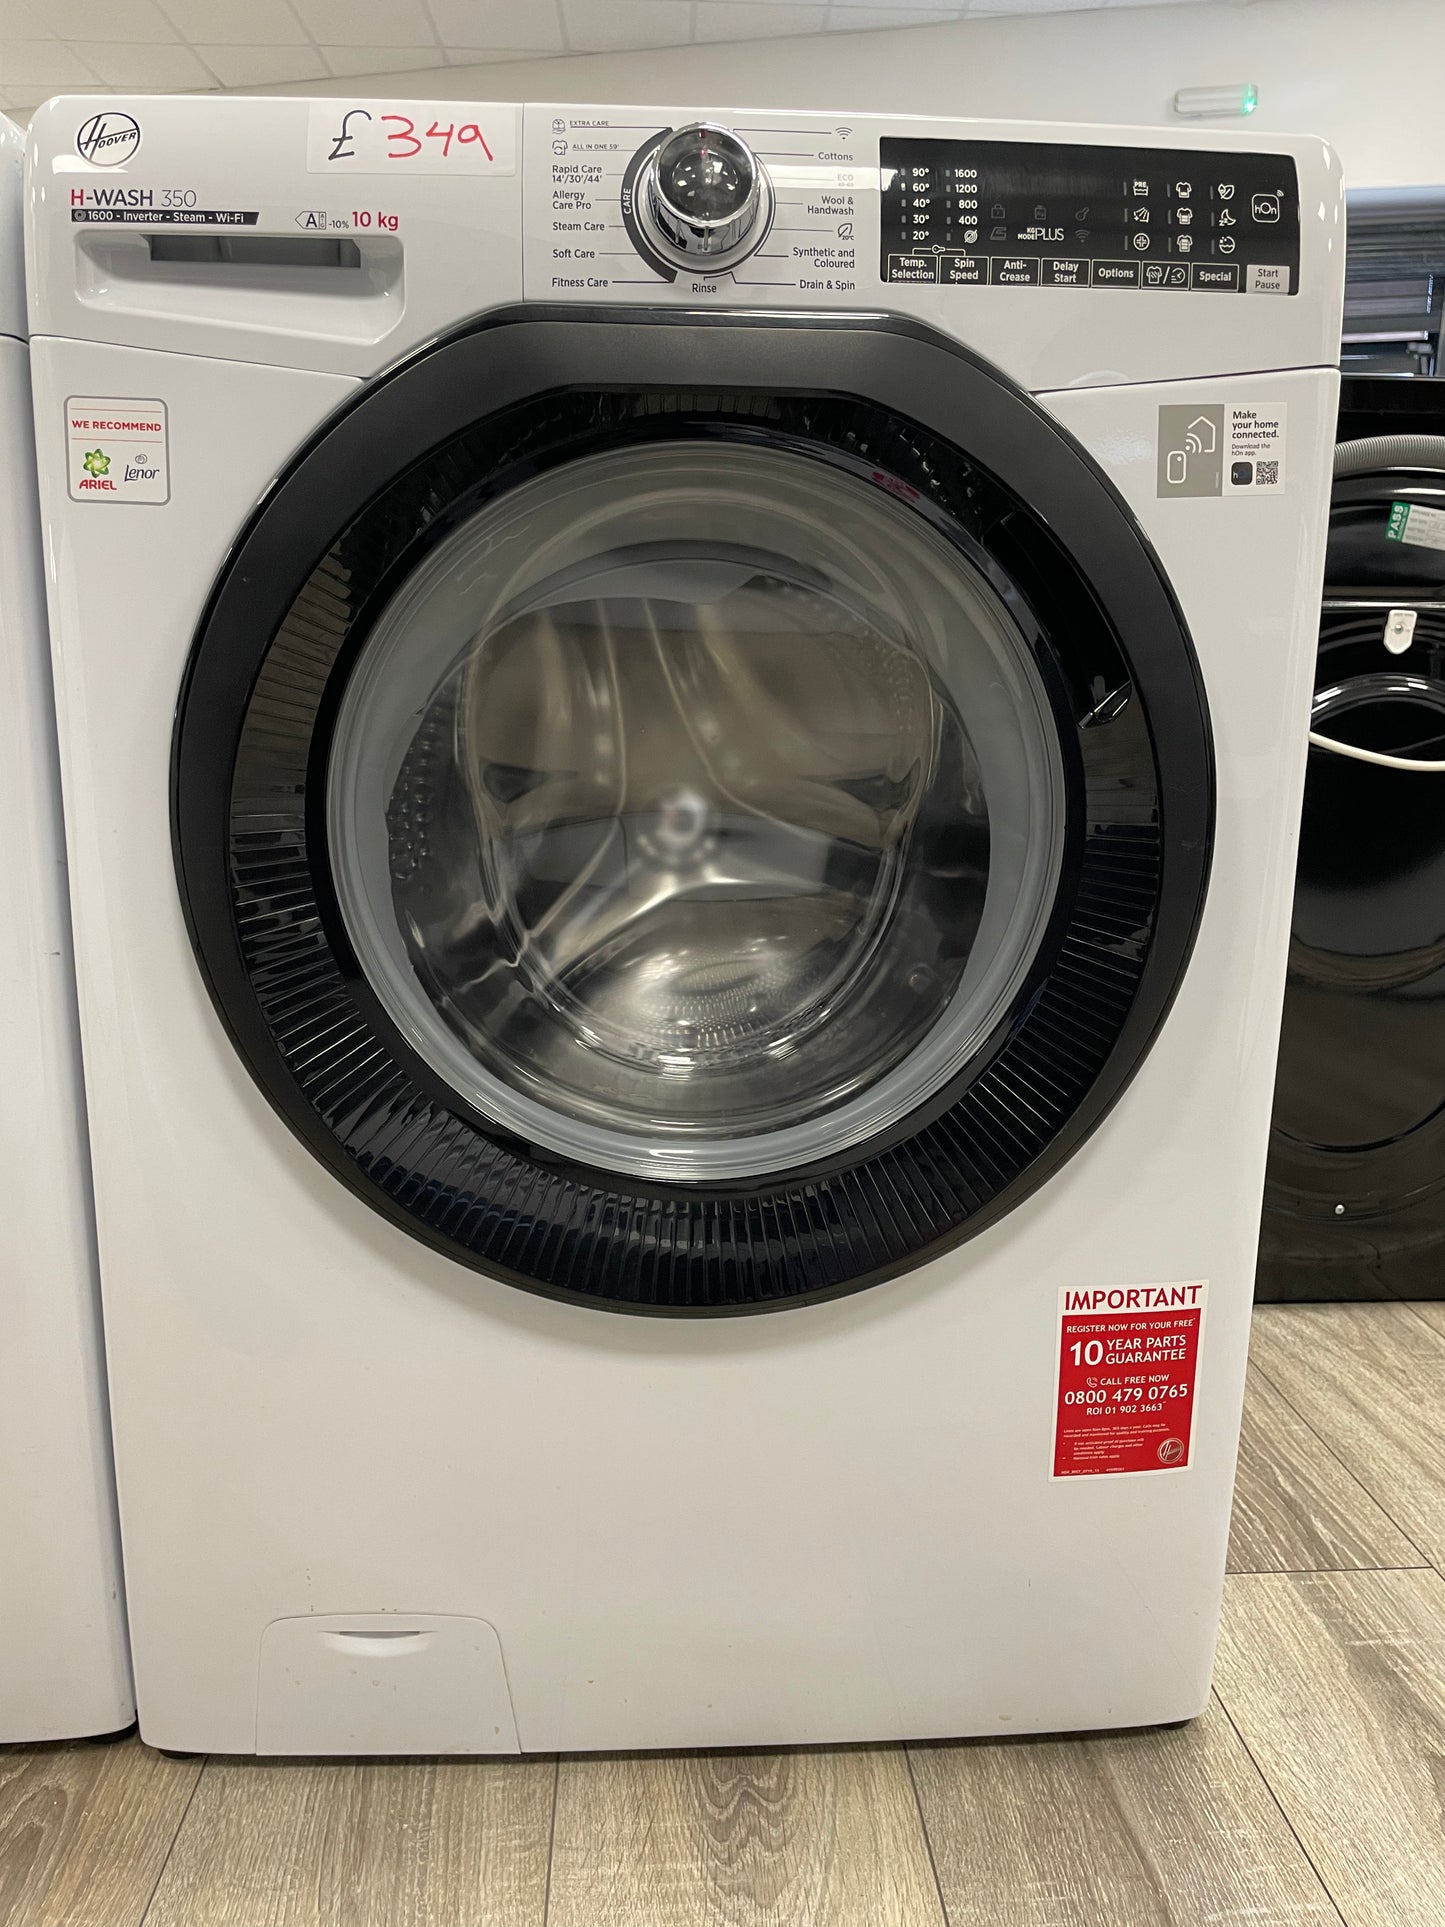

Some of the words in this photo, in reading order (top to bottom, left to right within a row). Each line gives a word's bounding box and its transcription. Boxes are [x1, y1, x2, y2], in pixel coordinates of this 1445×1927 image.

[818, 152, 853, 160] Cottons
[552, 165, 578, 174] Rapid
[582, 165, 602, 174] Care
[912, 168, 930, 177] 90°
[954, 169, 978, 178] 1600
[838, 174, 854, 182] ECO
[912, 183, 930, 192] 60°
[955, 184, 978, 194] 1200
[71, 189, 153, 207] H-WASH
[161, 190, 197, 208] 350
[552, 190, 585, 200] Allergy
[622, 188, 632, 214] CARE
[821, 196, 844, 204] Wool
[848, 197, 854, 205] &
[912, 199, 930, 208] 40°
[958, 200, 978, 209] 800
[552, 202, 573, 210] Care
[576, 202, 592, 210] Pro
[807, 206, 854, 215] Handwash
[1254, 202, 1276, 215] hOn
[88, 210, 113, 222] 1600
[124, 212, 163, 222] Inverter
[173, 212, 206, 222] Steam
[216, 213, 244, 224] Wi-Fi
[306, 213, 318, 228] A
[328, 220, 350, 229] -10%
[352, 211, 371, 227] 10
[378, 212, 398, 231] kg
[912, 214, 930, 224] 30°
[958, 216, 978, 225] 400
[552, 222, 582, 230] Steam
[584, 222, 605, 230] Care
[912, 230, 930, 240] 20°
[1036, 228, 1064, 240] PLUS
[552, 249, 572, 258] Soft
[574, 249, 595, 258] Care
[793, 247, 834, 258] Synthetic
[838, 249, 854, 258] and
[814, 259, 854, 268] Coloured
[900, 258, 927, 269] Temp.
[954, 258, 974, 270] Spin
[1004, 260, 1027, 270] Anti-
[1053, 262, 1078, 273] Delay
[892, 269, 934, 280] Selection
[950, 270, 978, 281] Speed
[1000, 272, 1030, 282] Crease
[1054, 273, 1076, 283] Start
[1098, 268, 1134, 280] Options
[1200, 270, 1232, 283] Special
[1258, 268, 1278, 278] Start
[552, 278, 584, 287] Fitness
[587, 278, 608, 288] Care
[800, 280, 824, 290] Drain
[826, 280, 833, 290] &
[836, 280, 856, 290] Spin
[1255, 280, 1280, 290] Pause
[692, 284, 716, 293] Rinse
[1232, 411, 1256, 419] Make
[72, 420, 89, 429] WE
[92, 420, 162, 432] RECOMMEND
[1232, 422, 1252, 431] your
[1254, 420, 1279, 428] home
[1232, 430, 1279, 439] connected.
[124, 464, 160, 482] Lenor
[78, 480, 117, 491] ARIEL
[1388, 505, 1404, 539] PASS
[1065, 1285, 1202, 1310] IMPORTANT
[1066, 1324, 1106, 1333] REGISTER
[1130, 1322, 1147, 1330] FOR
[1149, 1320, 1172, 1330] YOUR
[1070, 1340, 1103, 1366] 10
[1106, 1338, 1142, 1350] YEAR
[1146, 1334, 1186, 1349] PARTS
[1106, 1348, 1186, 1364] GUARANTEE
[1100, 1378, 1122, 1386] CALL
[1124, 1376, 1146, 1384] FREE
[1148, 1374, 1170, 1383] NOW
[1064, 1390, 1106, 1405] 0800
[1112, 1387, 1142, 1402] 479
[1148, 1384, 1188, 1400] 0765
[1086, 1407, 1102, 1416] ROI
[1105, 1406, 1116, 1414] 01
[1120, 1405, 1137, 1414] 902
